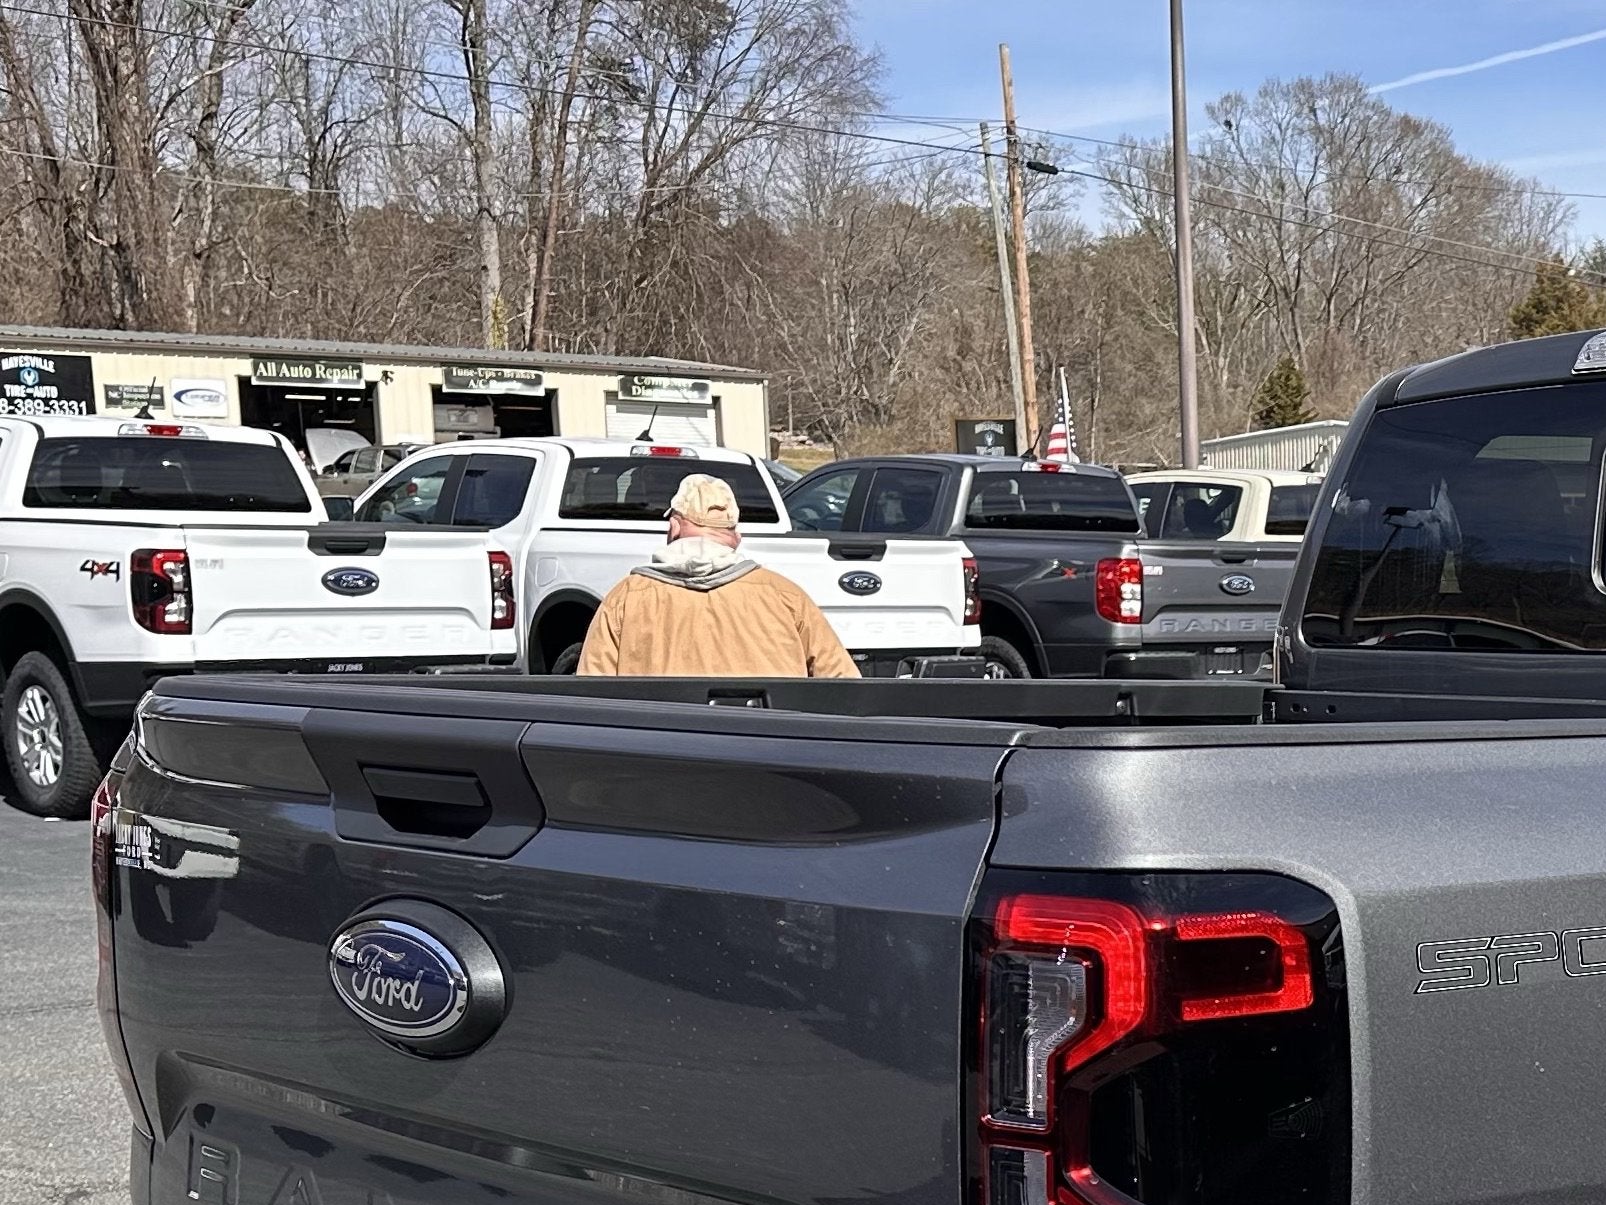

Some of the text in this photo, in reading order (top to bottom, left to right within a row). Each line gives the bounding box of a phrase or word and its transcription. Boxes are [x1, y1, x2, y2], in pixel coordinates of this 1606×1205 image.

[256, 361, 360, 383] All Auto Repair
[1160, 618, 1280, 633] RANGE
[351, 943, 425, 1012] Ford
